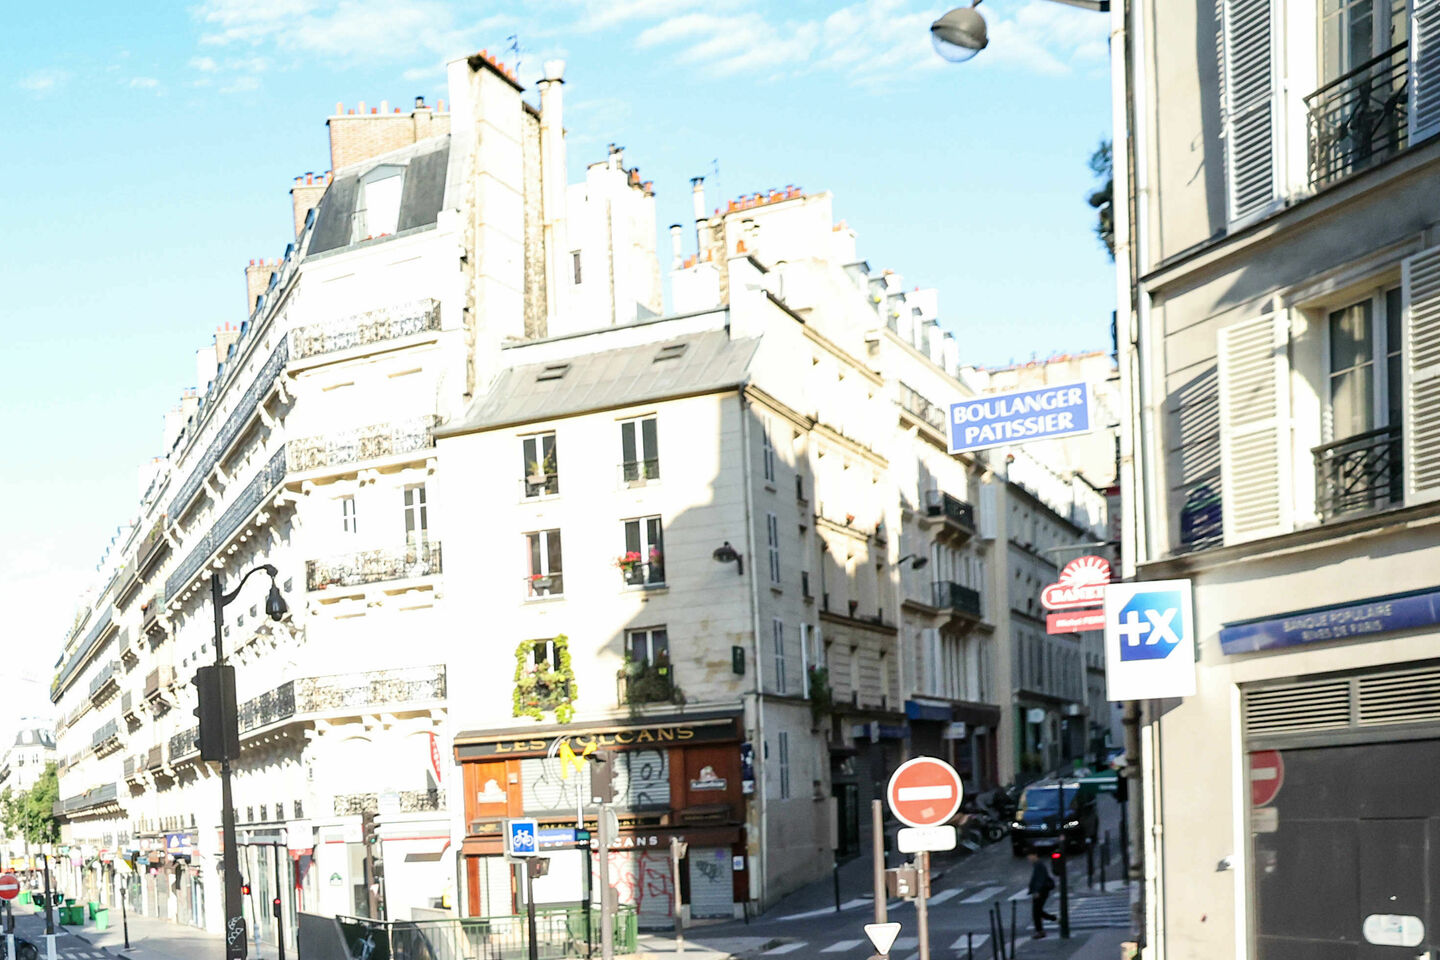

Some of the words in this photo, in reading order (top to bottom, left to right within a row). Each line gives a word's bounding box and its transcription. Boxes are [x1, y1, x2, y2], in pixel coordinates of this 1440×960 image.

[953, 388, 1083, 424] BOULANGER
[965, 412, 1074, 444] PATISSIER
[1284, 613, 1327, 633] BANQUE
[1330, 604, 1393, 625] POPULAIRE
[1334, 625, 1348, 638] DE
[1351, 620, 1382, 635] PARIS
[495, 740, 547, 752] LES
[563, 726, 695, 746] OLCANS
